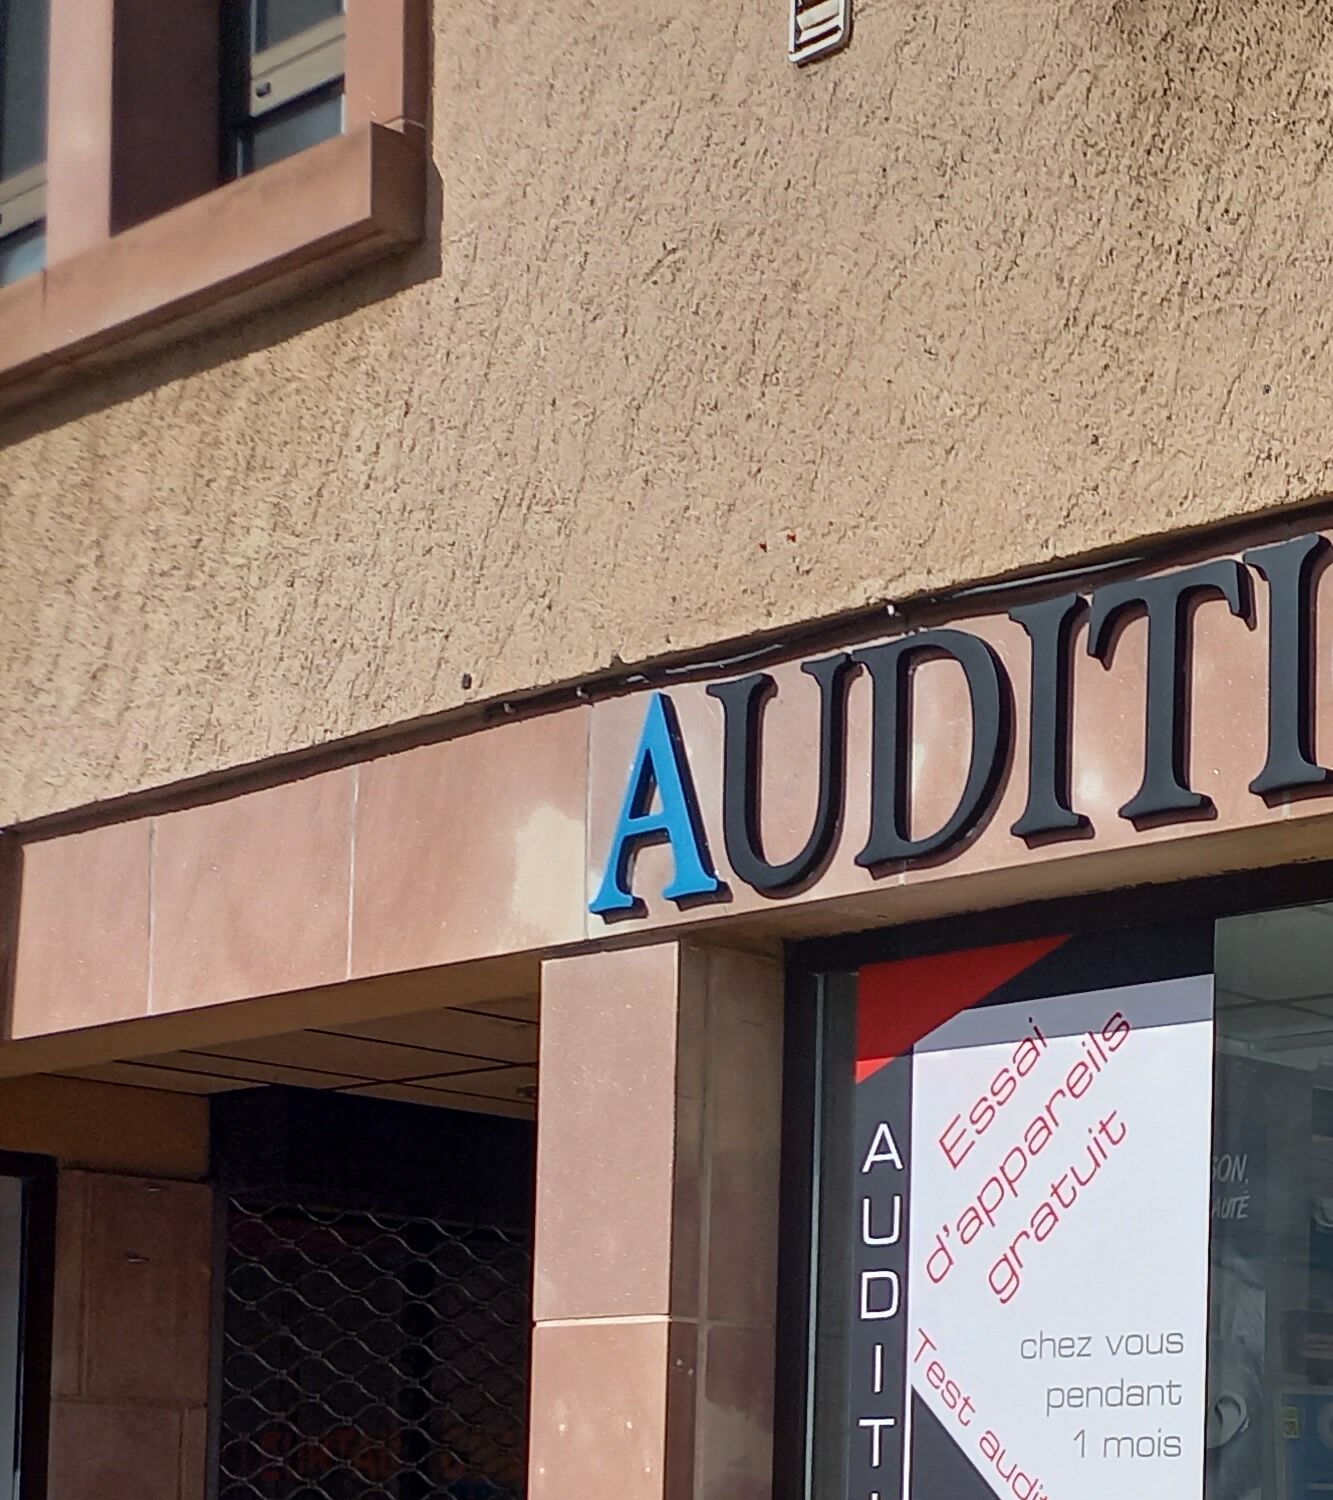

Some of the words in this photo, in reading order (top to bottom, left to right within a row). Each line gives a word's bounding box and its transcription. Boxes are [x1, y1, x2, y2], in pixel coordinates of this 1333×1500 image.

[938, 1016, 1048, 1169] Essai
[926, 1010, 1131, 1283] d'appareils
[988, 1110, 1127, 1304] gratuit
[912, 1328, 975, 1428] Test
[1020, 1331, 1092, 1359] chez
[1107, 1330, 1184, 1356] vous
[1046, 1378, 1182, 1416] pendant
[1073, 1430, 1086, 1457] 1
[1103, 1427, 1182, 1458] mois
